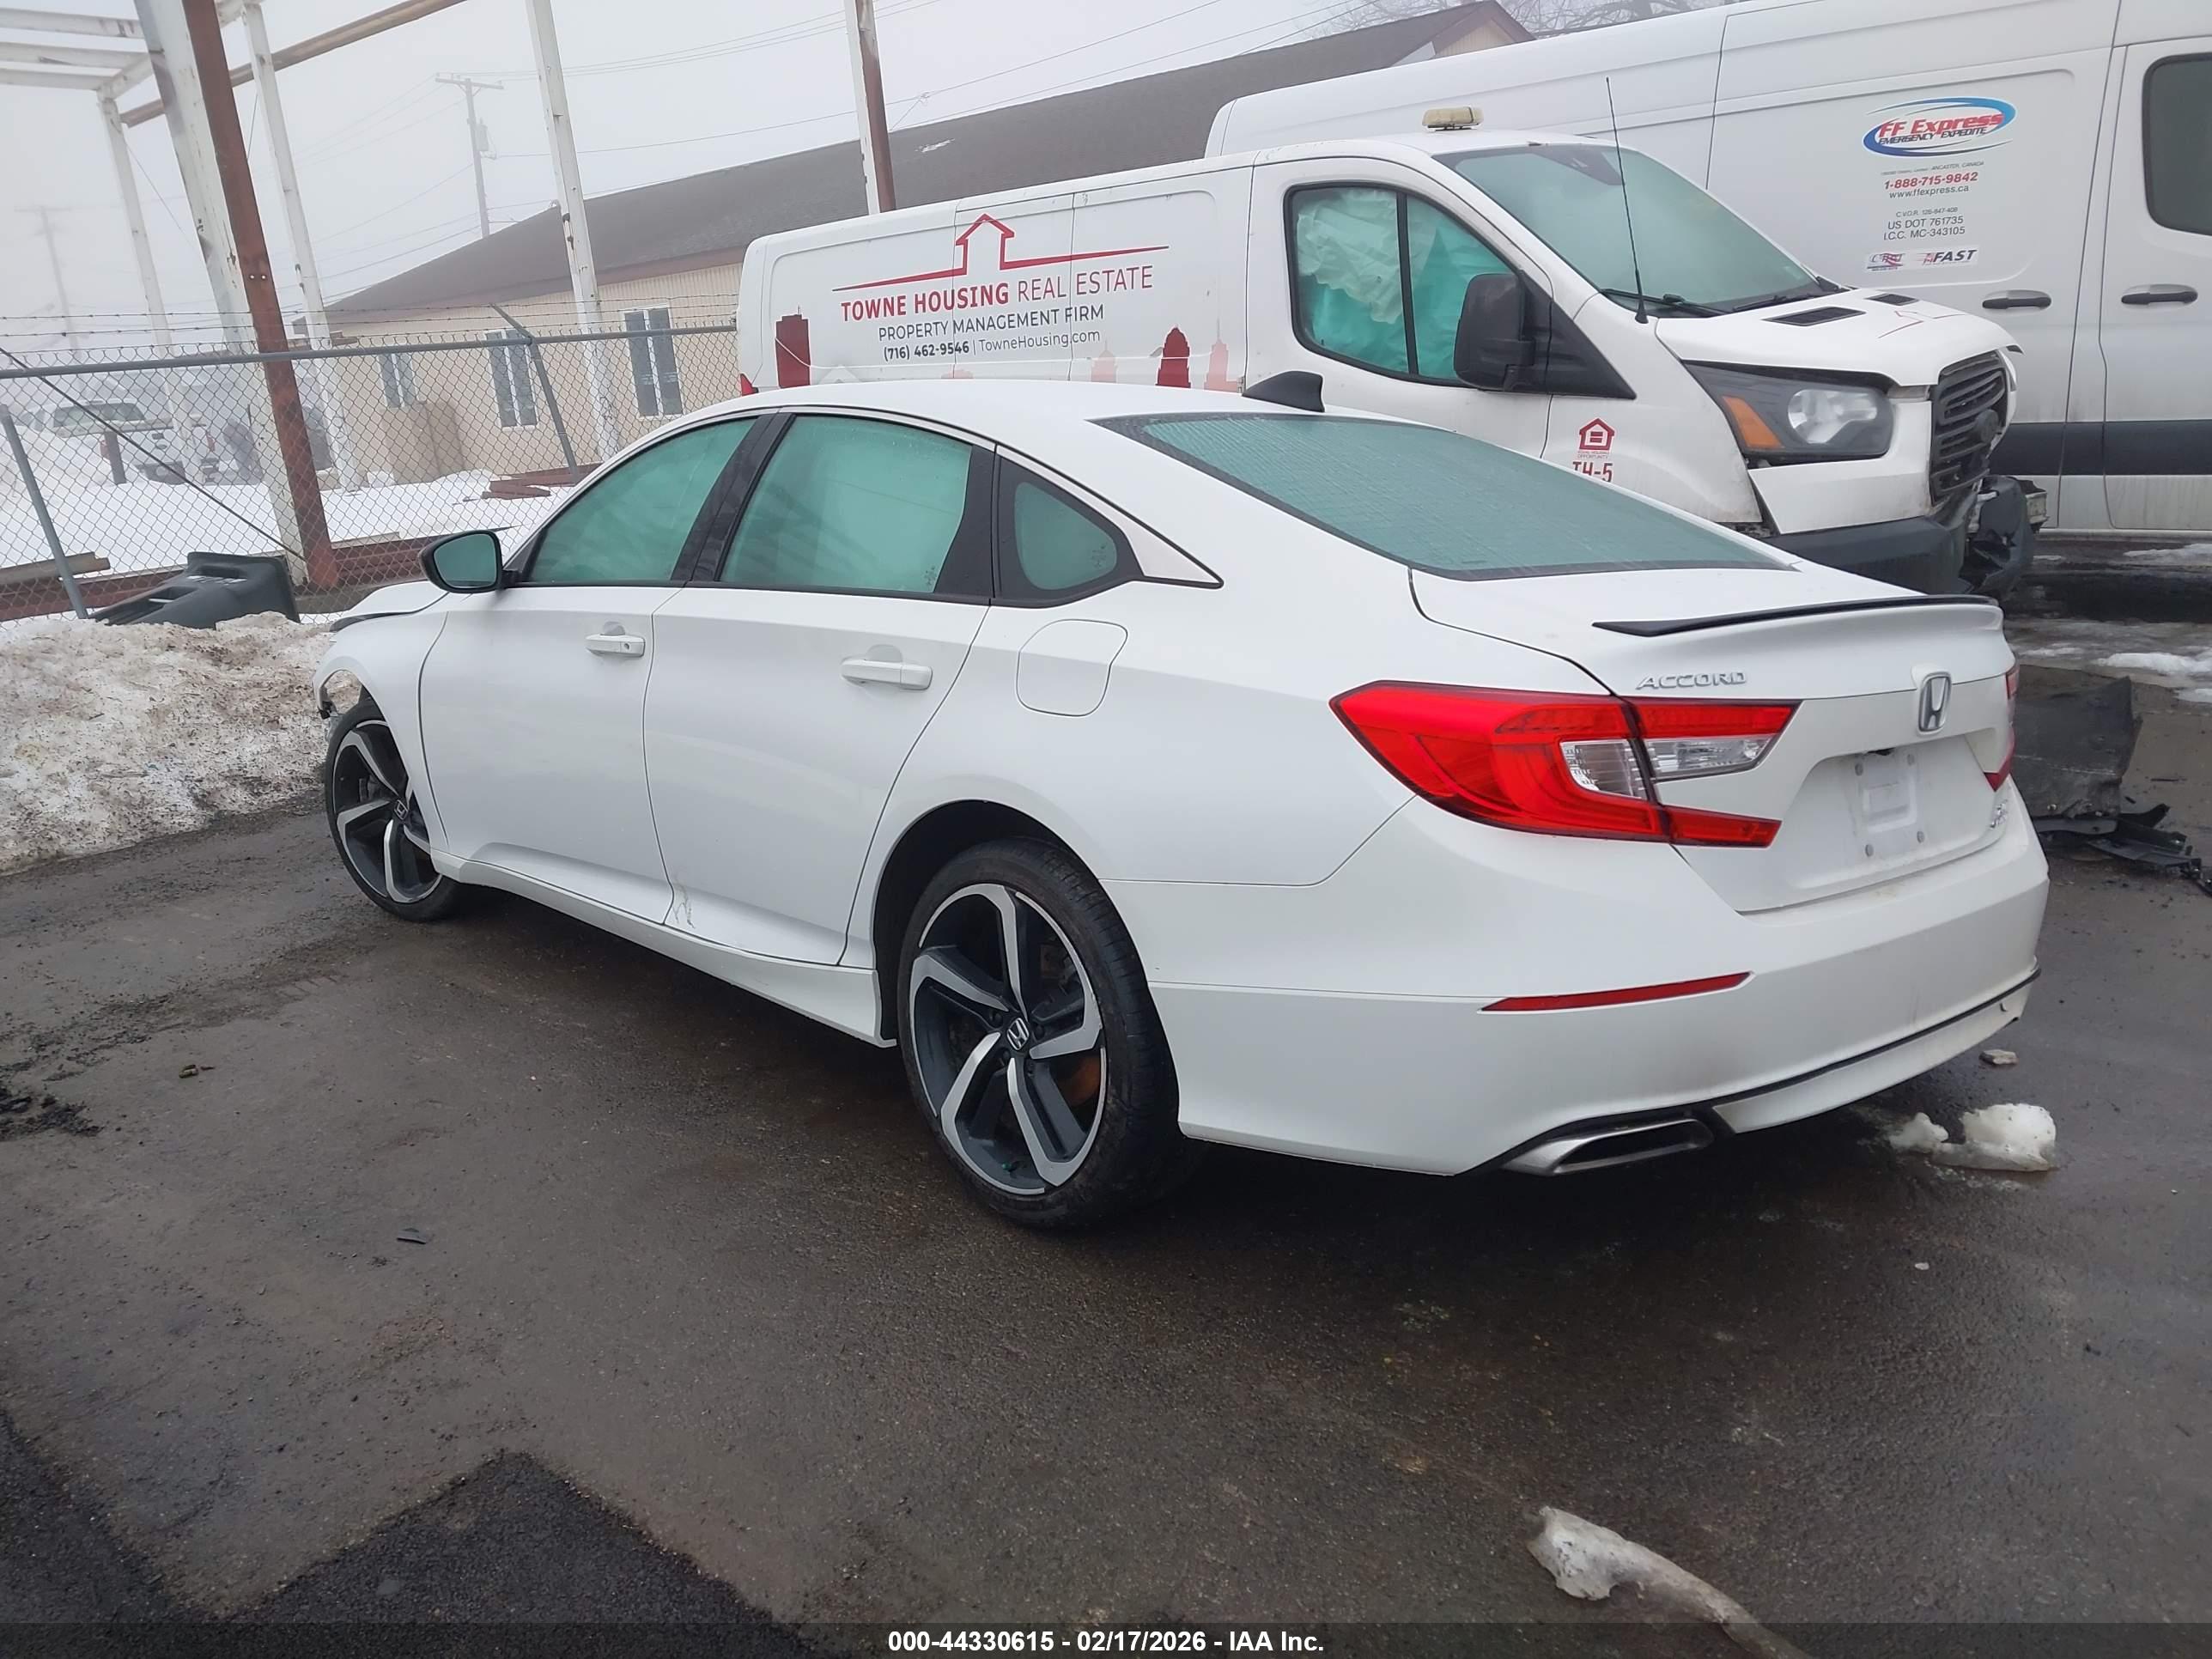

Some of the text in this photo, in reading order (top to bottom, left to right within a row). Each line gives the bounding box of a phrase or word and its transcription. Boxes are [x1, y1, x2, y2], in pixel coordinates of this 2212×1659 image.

[1879, 114, 2004, 137] FF Express
[1884, 172, 1978, 190] 1-888-715-9842
[1889, 185, 1969, 198] www.ffexpress.ca
[1888, 216, 1964, 229] US DOT 761735
[1910, 226, 1966, 238] MC-343105
[1933, 249, 1977, 262] FAST
[841, 265, 1153, 321] TOWNE HOUSING REAL ESTATE
[878, 304, 1104, 341] PROPERTY MANAGEMENT FIRM
[884, 344, 910, 362] (716)
[914, 341, 969, 357] 462-9546
[979, 330, 1100, 352] TowneHousing.com
[1636, 672, 1747, 690] ACCORD
